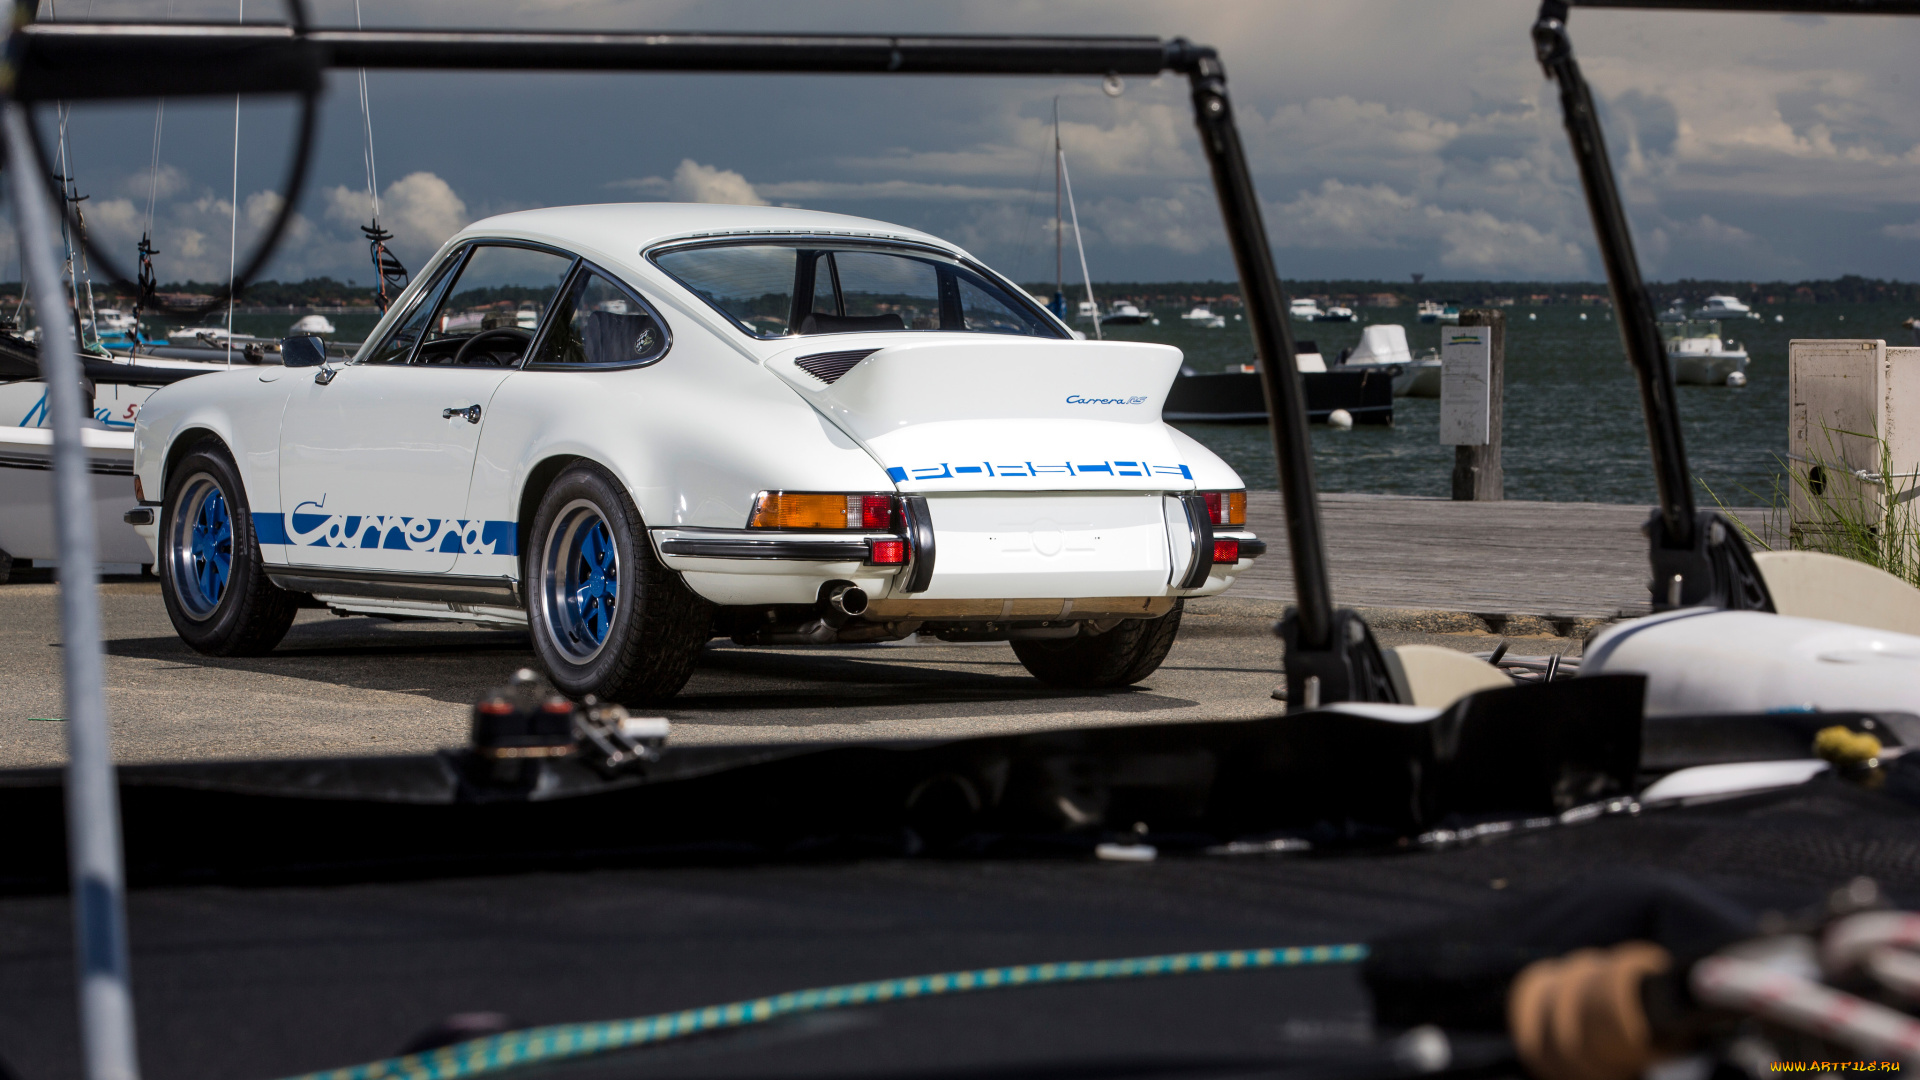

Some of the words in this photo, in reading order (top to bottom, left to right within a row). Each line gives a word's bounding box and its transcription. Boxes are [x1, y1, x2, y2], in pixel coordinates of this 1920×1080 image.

[1066, 395, 1125, 405] Carrera
[898, 460, 1188, 482] PORSCHE
[284, 492, 497, 556] Carrera
